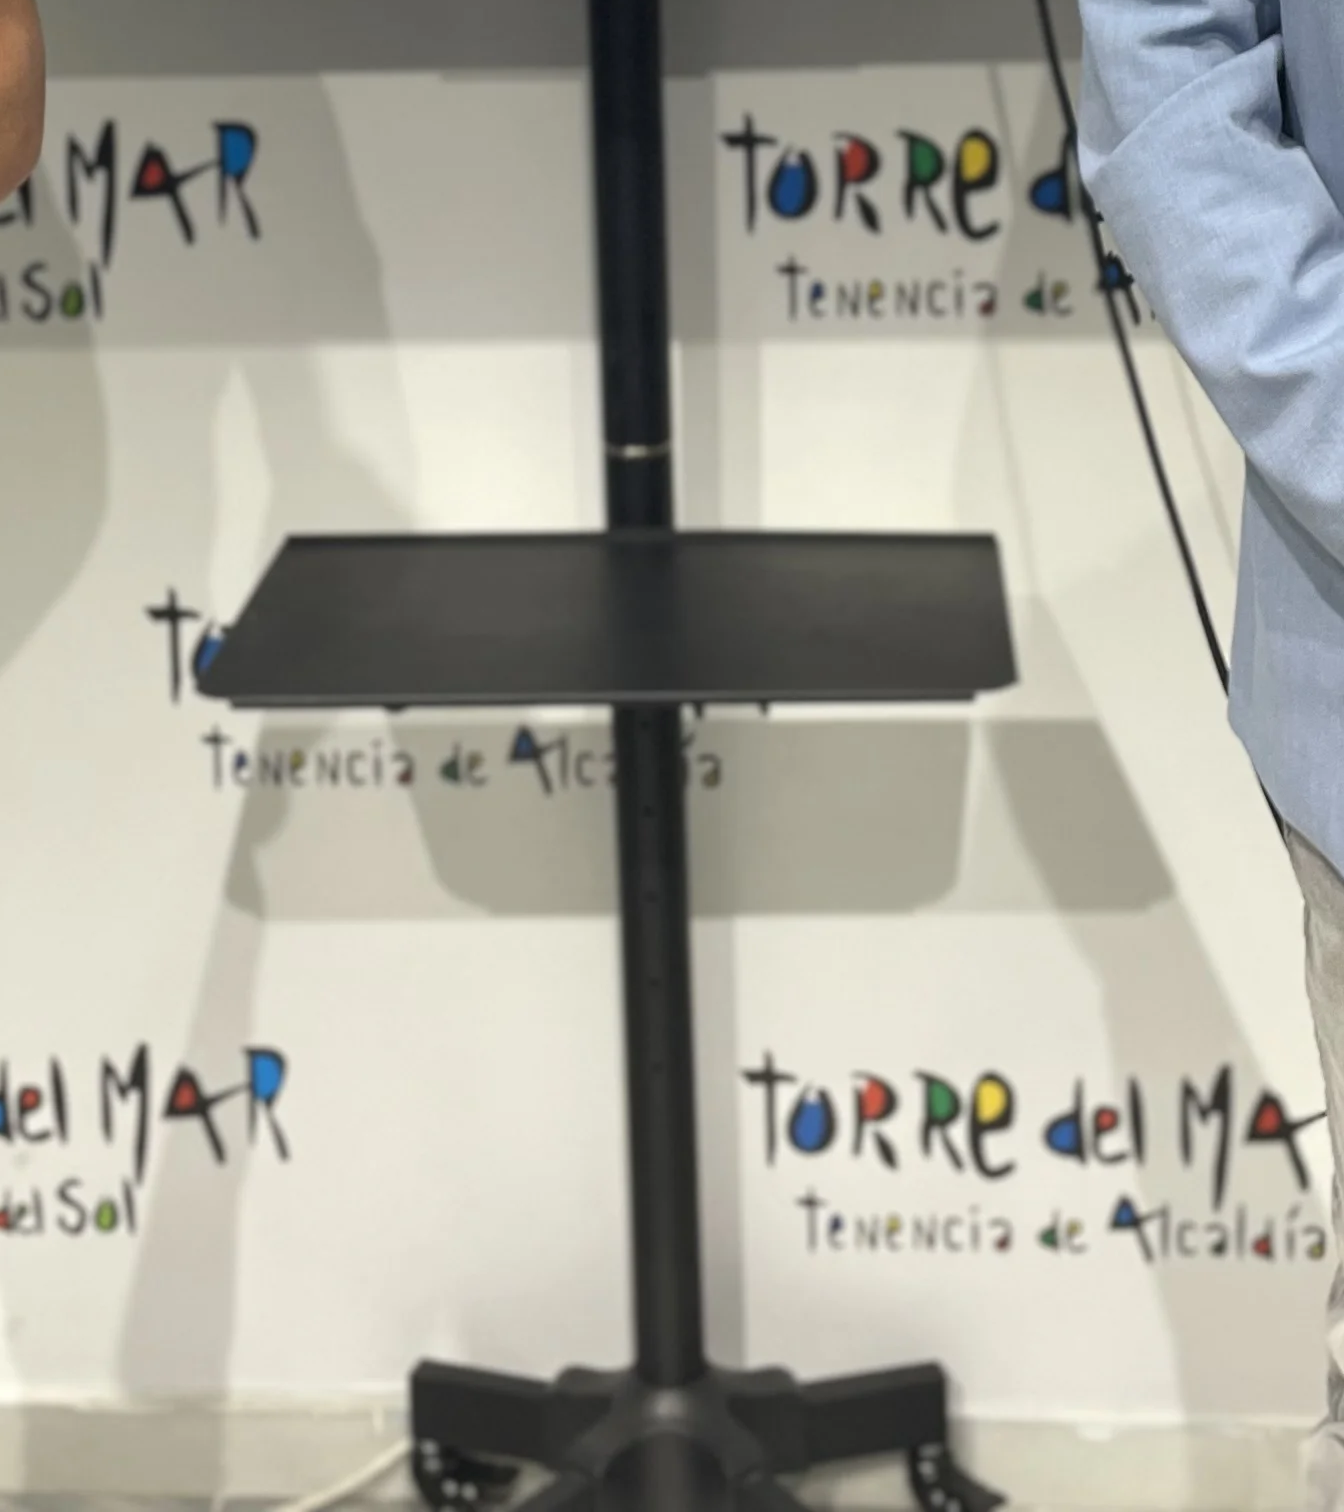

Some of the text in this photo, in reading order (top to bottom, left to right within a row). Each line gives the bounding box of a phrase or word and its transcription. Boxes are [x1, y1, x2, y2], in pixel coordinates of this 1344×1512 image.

[65, 118, 262, 271] MAR
[22, 260, 104, 322] Sol
[1022, 271, 1074, 318] de
[440, 740, 487, 788] de
[101, 1044, 290, 1186] MAR
[1042, 1076, 1145, 1166] del
[1179, 1063, 1328, 1213] MA
[56, 1178, 136, 1235] Sol
[1038, 1208, 1087, 1253] de
